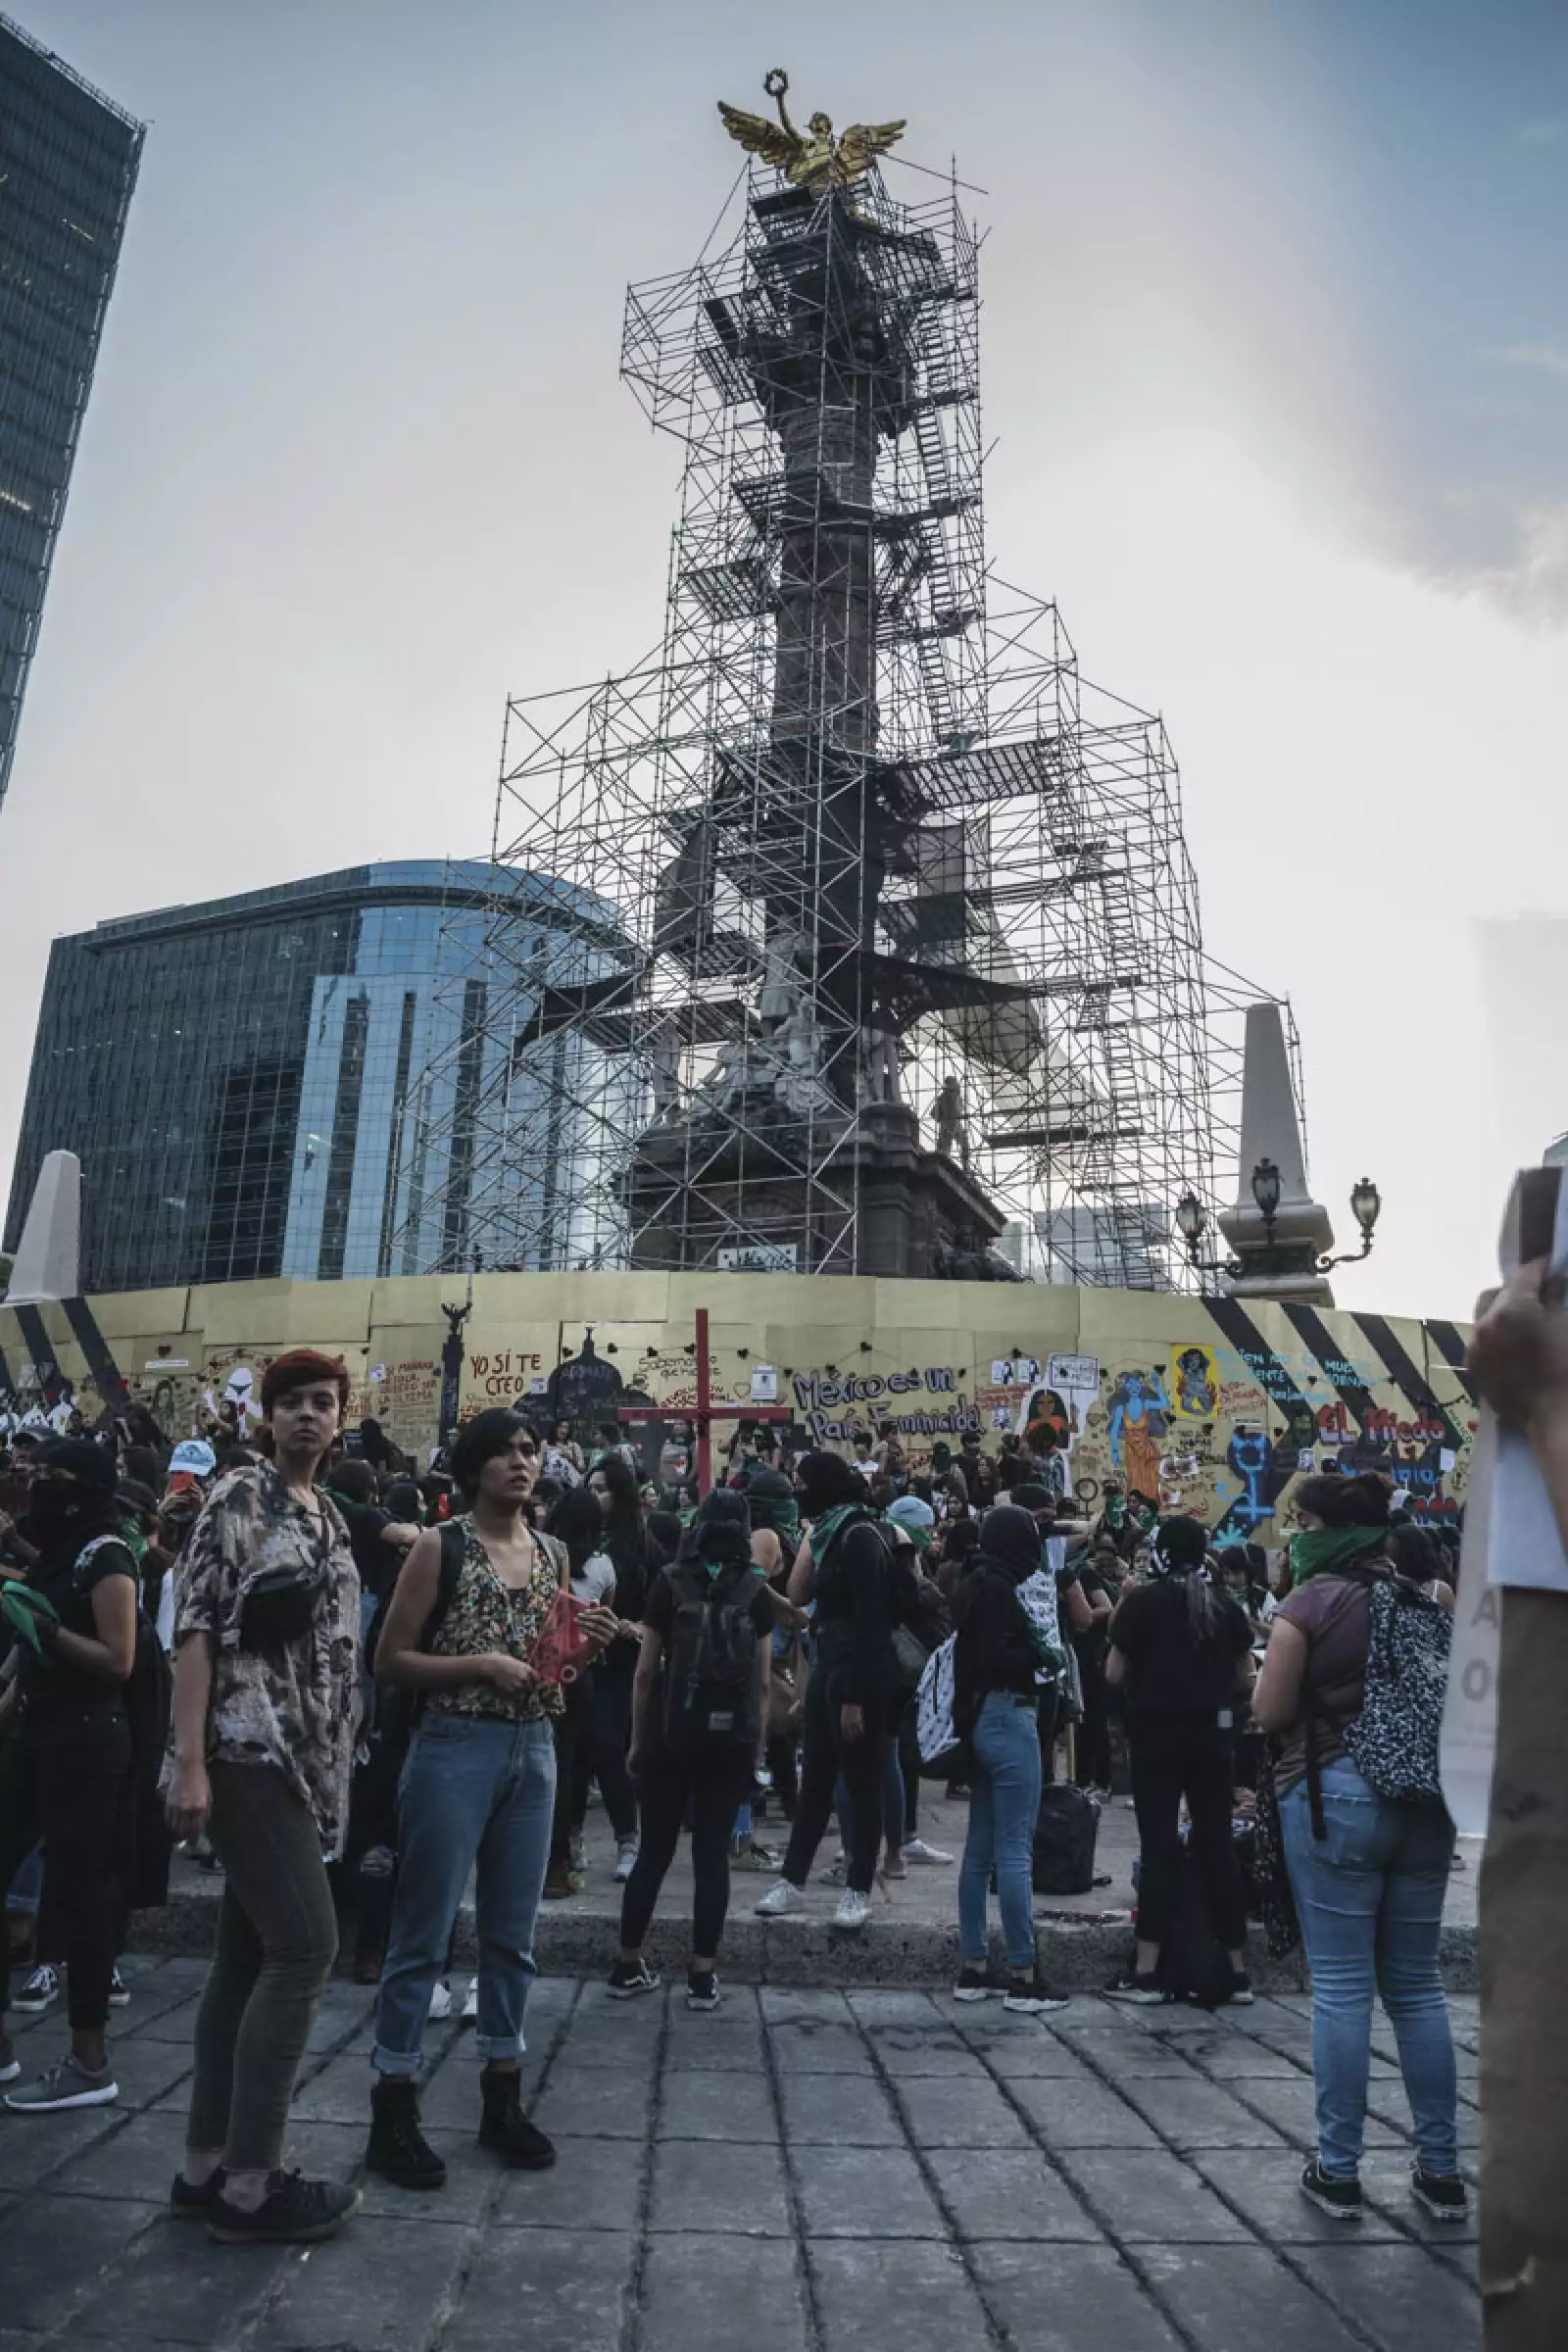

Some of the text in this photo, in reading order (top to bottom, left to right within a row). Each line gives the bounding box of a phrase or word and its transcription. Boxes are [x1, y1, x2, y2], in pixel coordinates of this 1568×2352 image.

[470, 1356, 488, 1379] YO
[515, 1354, 541, 1374] TE
[888, 1370, 921, 1394] es
